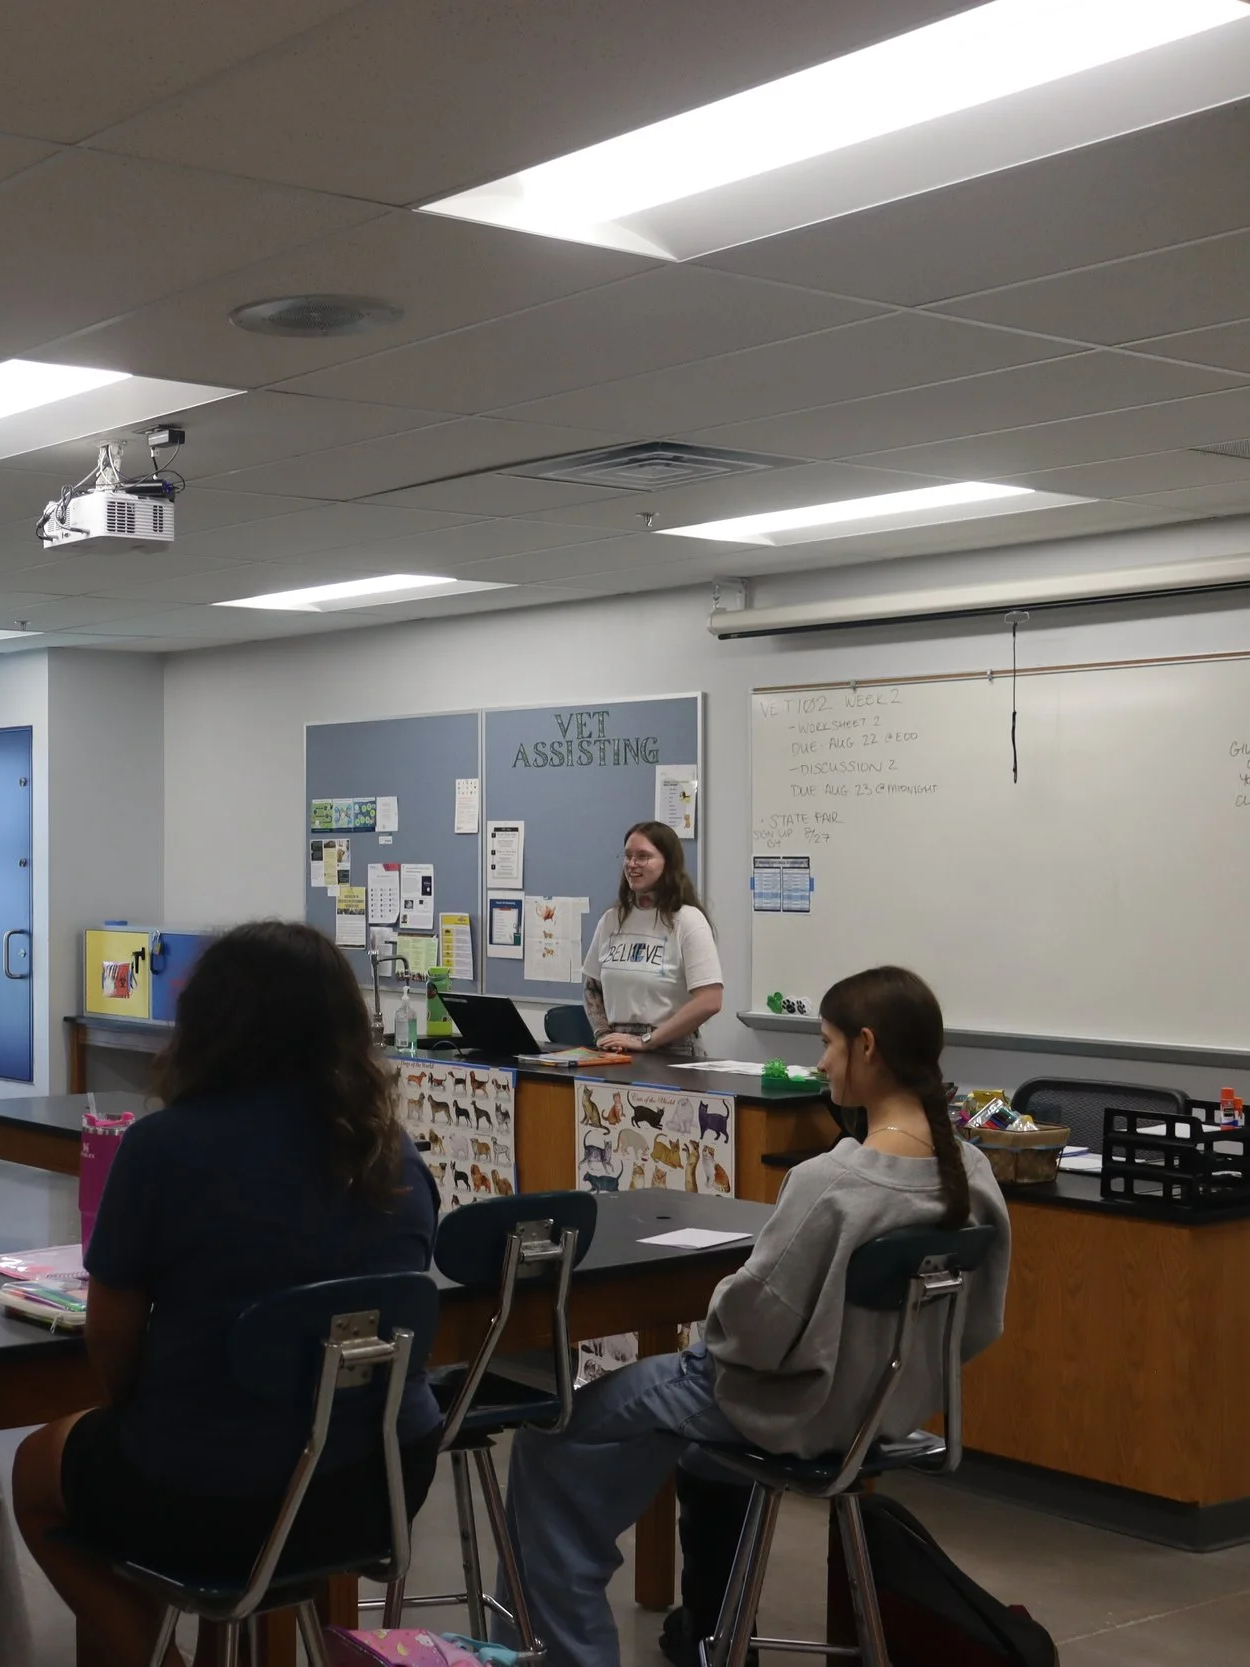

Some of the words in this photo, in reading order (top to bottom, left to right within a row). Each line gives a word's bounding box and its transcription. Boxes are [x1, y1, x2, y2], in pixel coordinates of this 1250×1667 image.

[890, 688, 904, 704] 2
[554, 711, 609, 739] VET
[873, 715, 881, 727] 2
[828, 736, 854, 750] AUG
[862, 733, 878, 747] 22
[512, 737, 660, 768] ASSISTING
[888, 759, 898, 772] 2
[791, 783, 817, 798] DUE
[824, 783, 849, 797] AUG
[854, 783, 873, 797] 23
[770, 813, 809, 829] STATE
[814, 811, 845, 825] FAIR
[778, 829, 793, 838] UP
[804, 826, 831, 845] 8/27
[603, 942, 665, 966] BELIEVE
